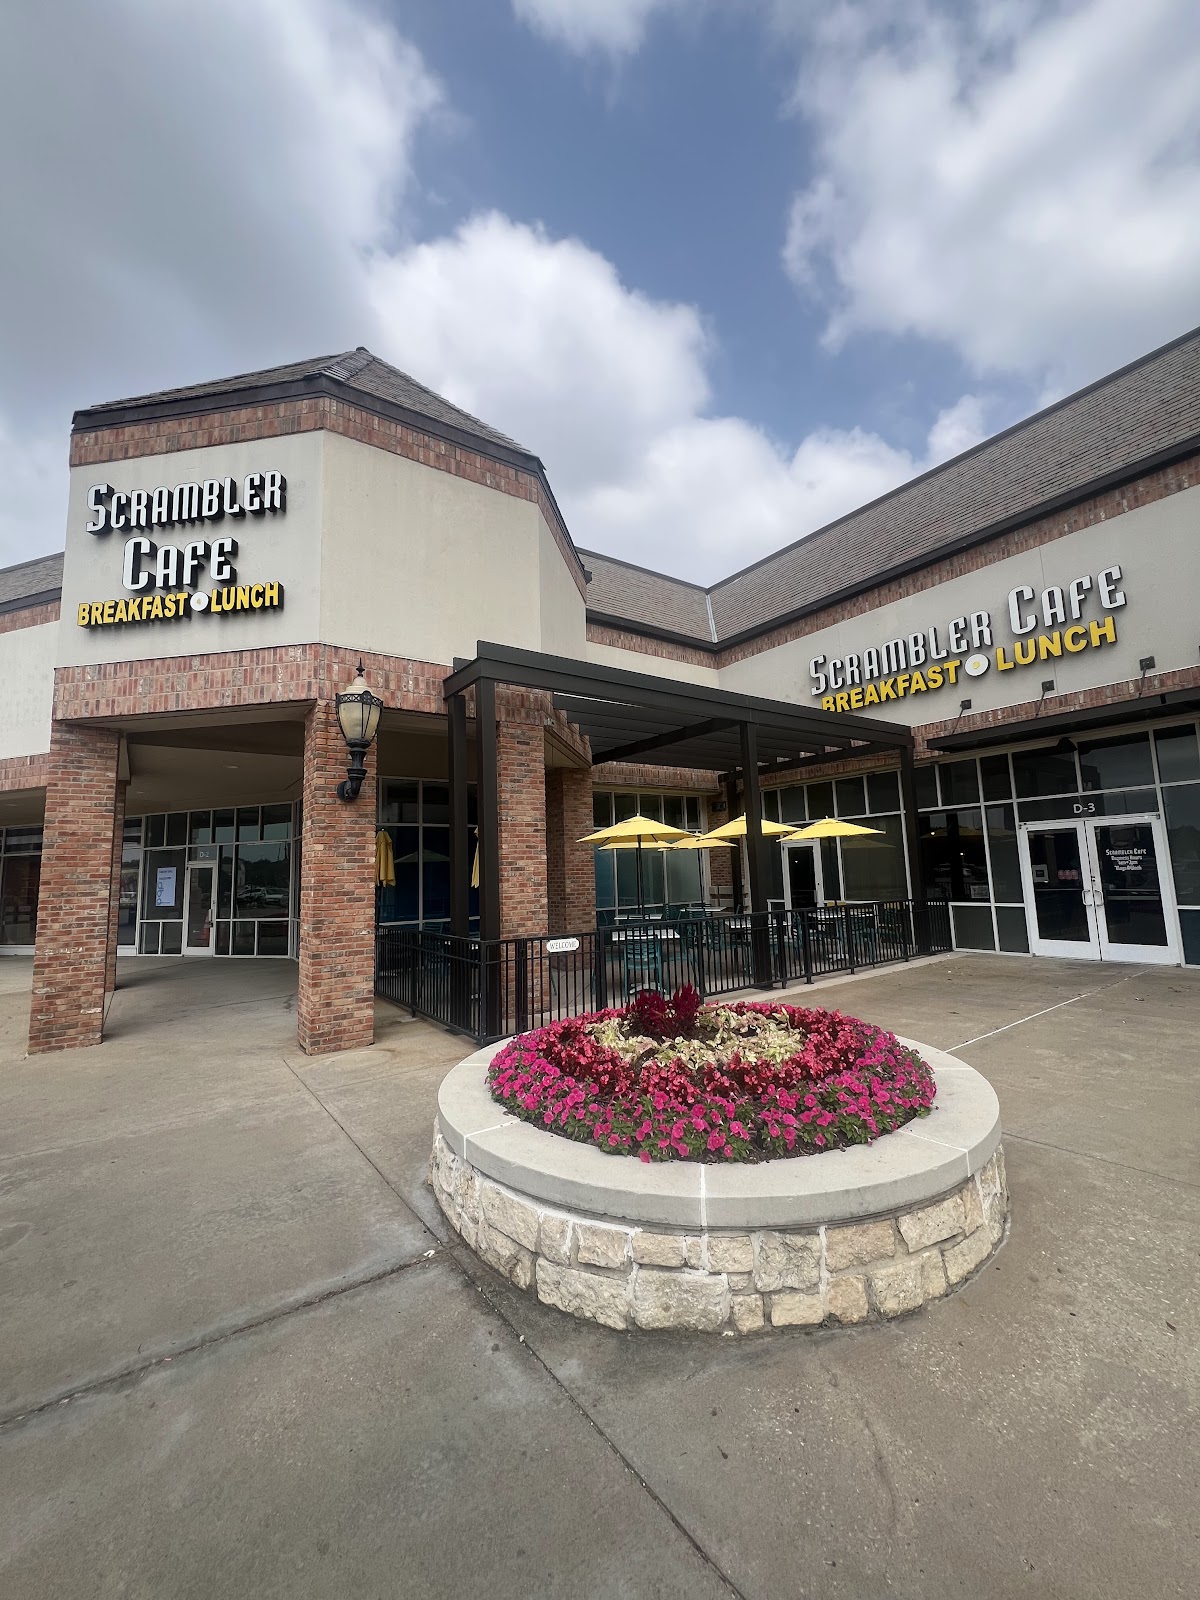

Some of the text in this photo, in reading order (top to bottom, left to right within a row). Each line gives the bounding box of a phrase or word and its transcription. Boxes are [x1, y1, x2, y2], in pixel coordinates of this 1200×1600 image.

[86, 470, 286, 535] SCRAMBLER
[122, 536, 238, 591] CAFE
[77, 581, 283, 628] BREAKFAST LUNCH
[809, 564, 1127, 695] SCRAMBLER CAFE
[822, 615, 1117, 713] BREAKFAST LUNCH
[1073, 803, 1096, 814] D-3
[550, 941, 577, 950] WELCOME
